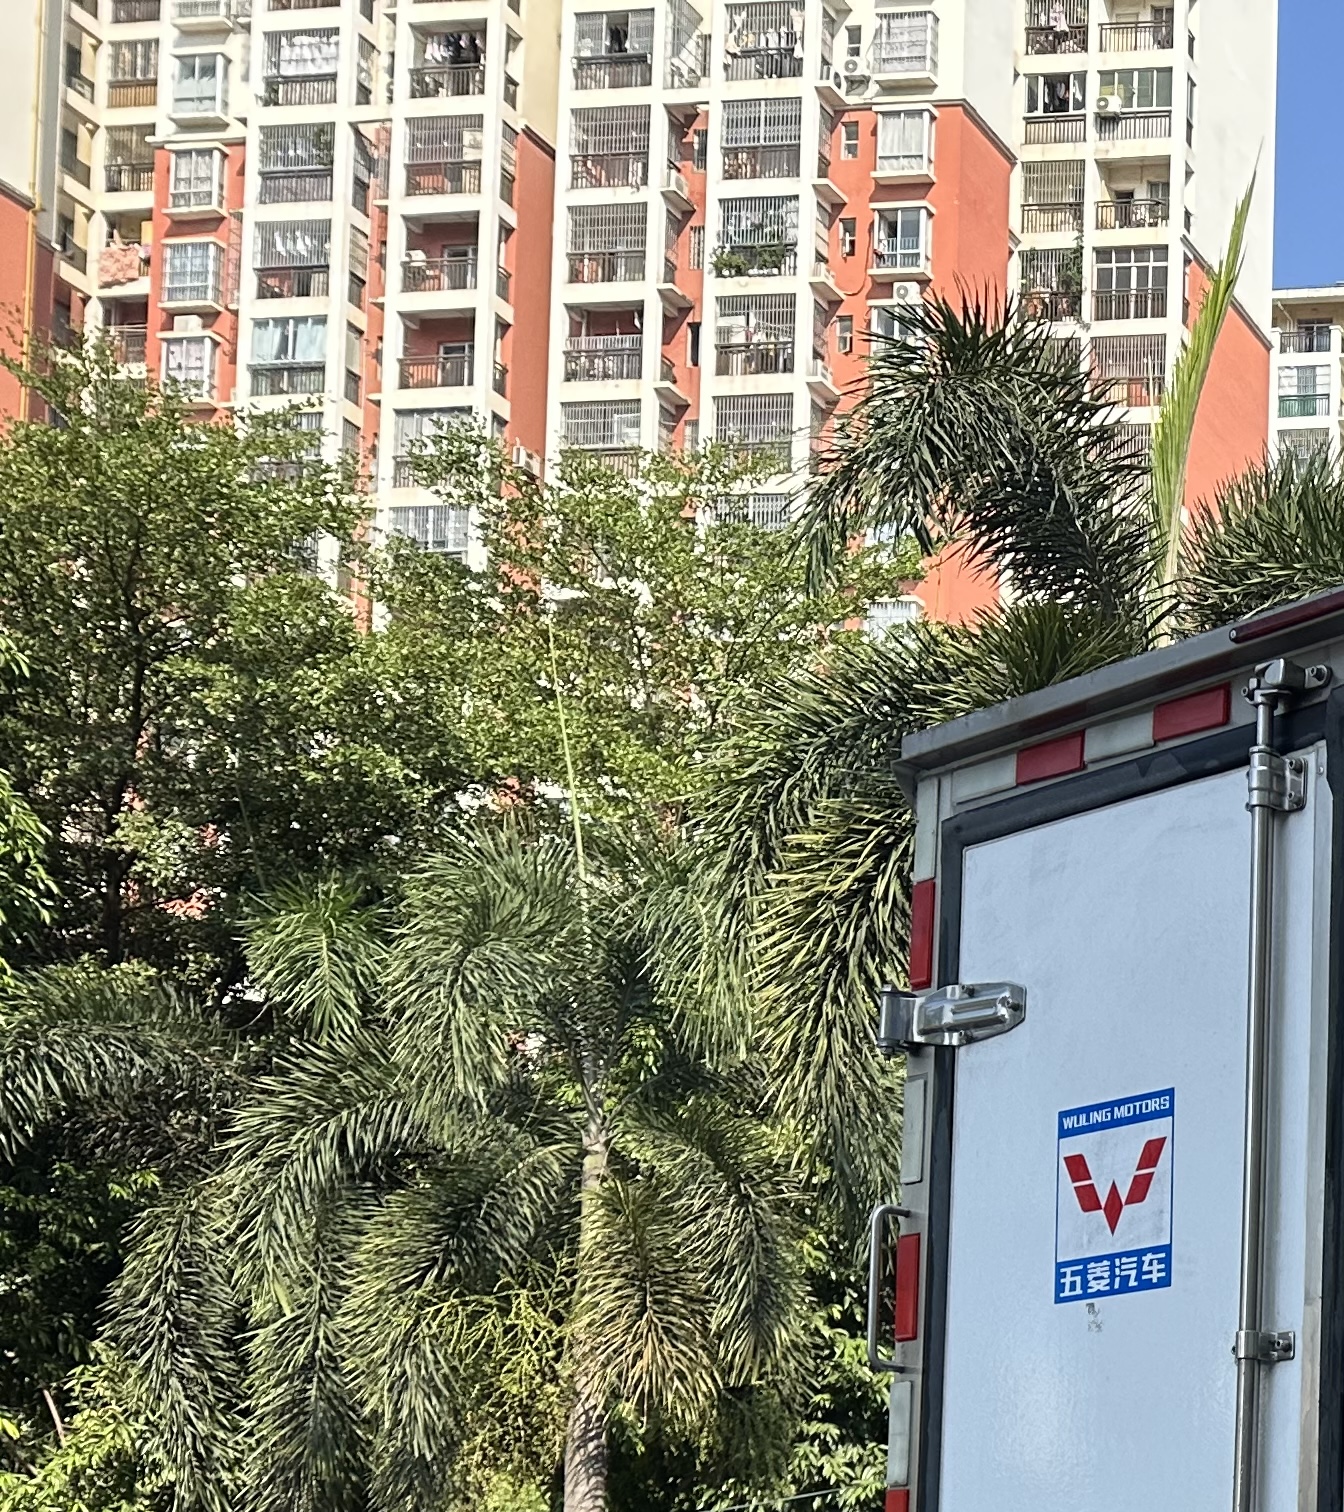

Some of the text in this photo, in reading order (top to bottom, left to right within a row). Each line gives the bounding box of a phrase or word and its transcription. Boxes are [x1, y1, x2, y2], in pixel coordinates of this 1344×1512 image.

[1062, 1095, 1170, 1130] WULING MOTORS
[1059, 1252, 1167, 1298] 五菱汽车
